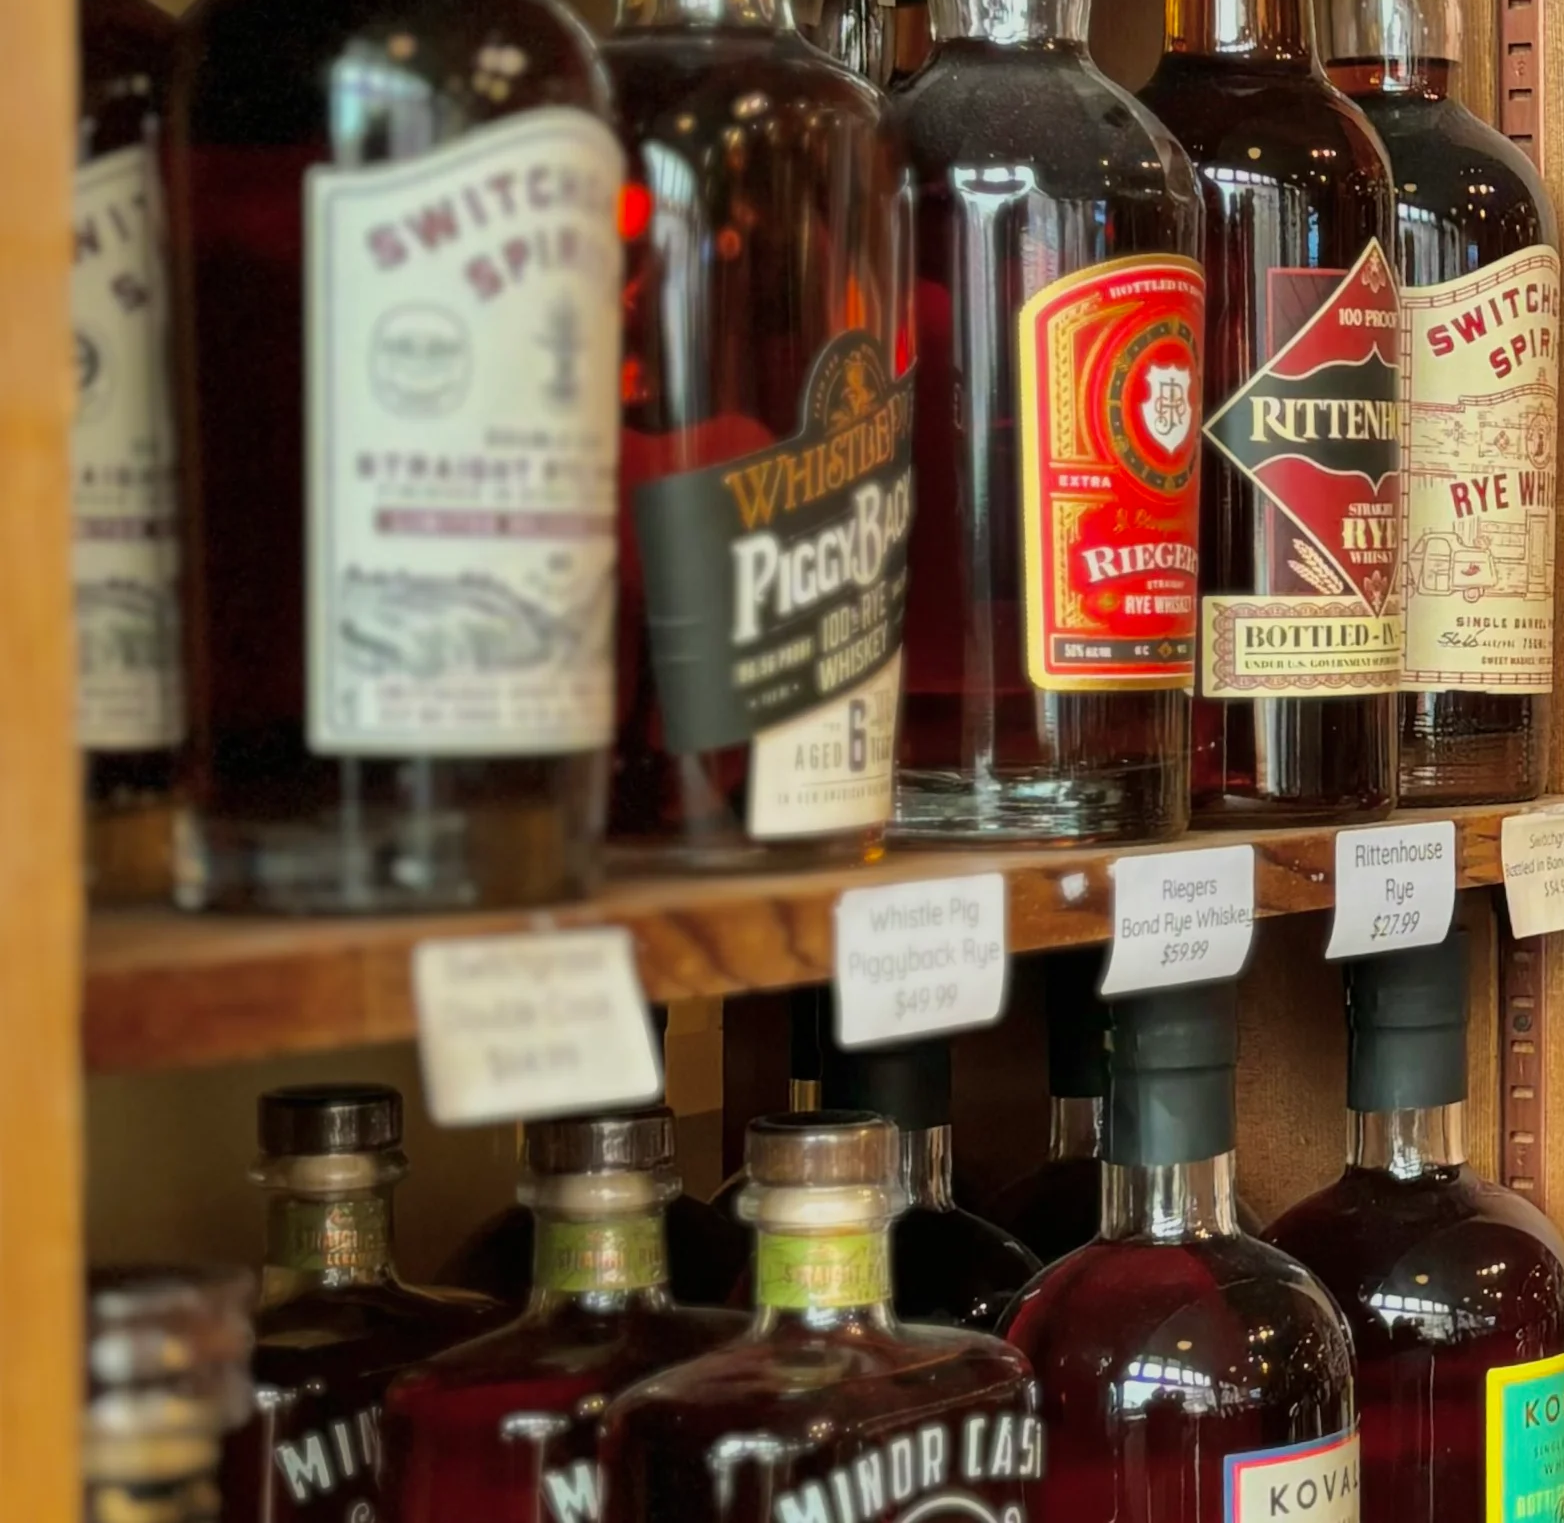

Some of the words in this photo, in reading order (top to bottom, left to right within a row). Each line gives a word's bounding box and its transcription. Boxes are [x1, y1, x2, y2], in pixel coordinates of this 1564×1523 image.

[1110, 277, 1176, 300] BOTTLED
[1338, 307, 1362, 326] 100
[1058, 474, 1112, 490] EXTRA
[1449, 472, 1509, 520] RYE
[1341, 517, 1397, 550] RYE
[1350, 549, 1394, 565] WHISKY
[861, 579, 888, 632] RYE
[1124, 594, 1151, 615] RYE
[1244, 624, 1369, 649] BOTTLED
[1456, 616, 1508, 629] SINGLE
[816, 620, 889, 695] WHISKEY
[794, 737, 845, 774] AGED
[847, 697, 867, 774] 6
[1355, 838, 1443, 869] Rittenhouse
[1162, 876, 1217, 901] Riegers
[1385, 878, 1415, 905] Rye
[869, 898, 944, 933] Whistle
[948, 897, 980, 931] Pig
[1121, 915, 1159, 939] Bond
[1163, 911, 1193, 937] Rye
[1195, 904, 1254, 931] Whiskey
[1370, 910, 1421, 941] $27.99
[847, 942, 957, 986] Piggyback
[961, 937, 1001, 968] Rye
[1161, 939, 1210, 968] $59.99
[894, 983, 958, 1021] $49.99
